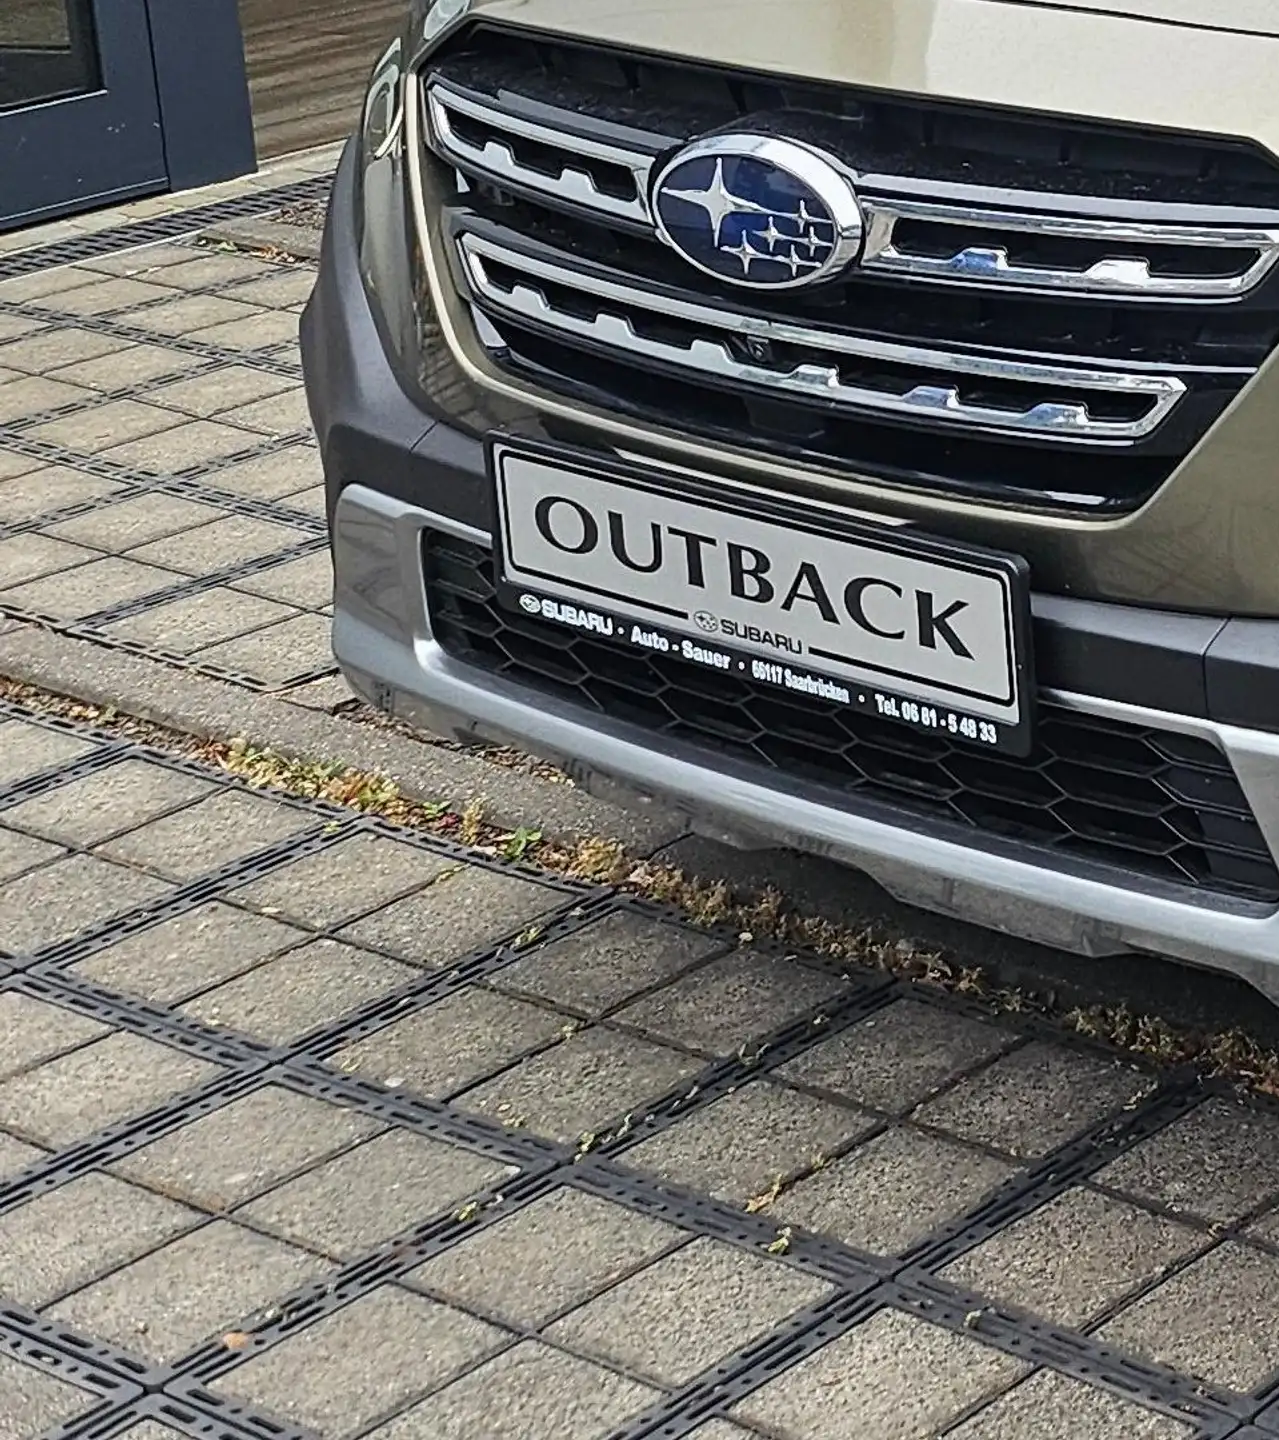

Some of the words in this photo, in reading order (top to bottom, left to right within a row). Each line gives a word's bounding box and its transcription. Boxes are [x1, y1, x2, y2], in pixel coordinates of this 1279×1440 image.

[534, 495, 976, 661] OUTBACK
[720, 618, 802, 655] SUBARU
[541, 598, 613, 636] SUBARU
[630, 625, 669, 652] Auto
[681, 639, 731, 670] Sauer
[874, 693, 900, 717] Tel.
[959, 716, 977, 738] 48
[978, 721, 997, 744] 33
